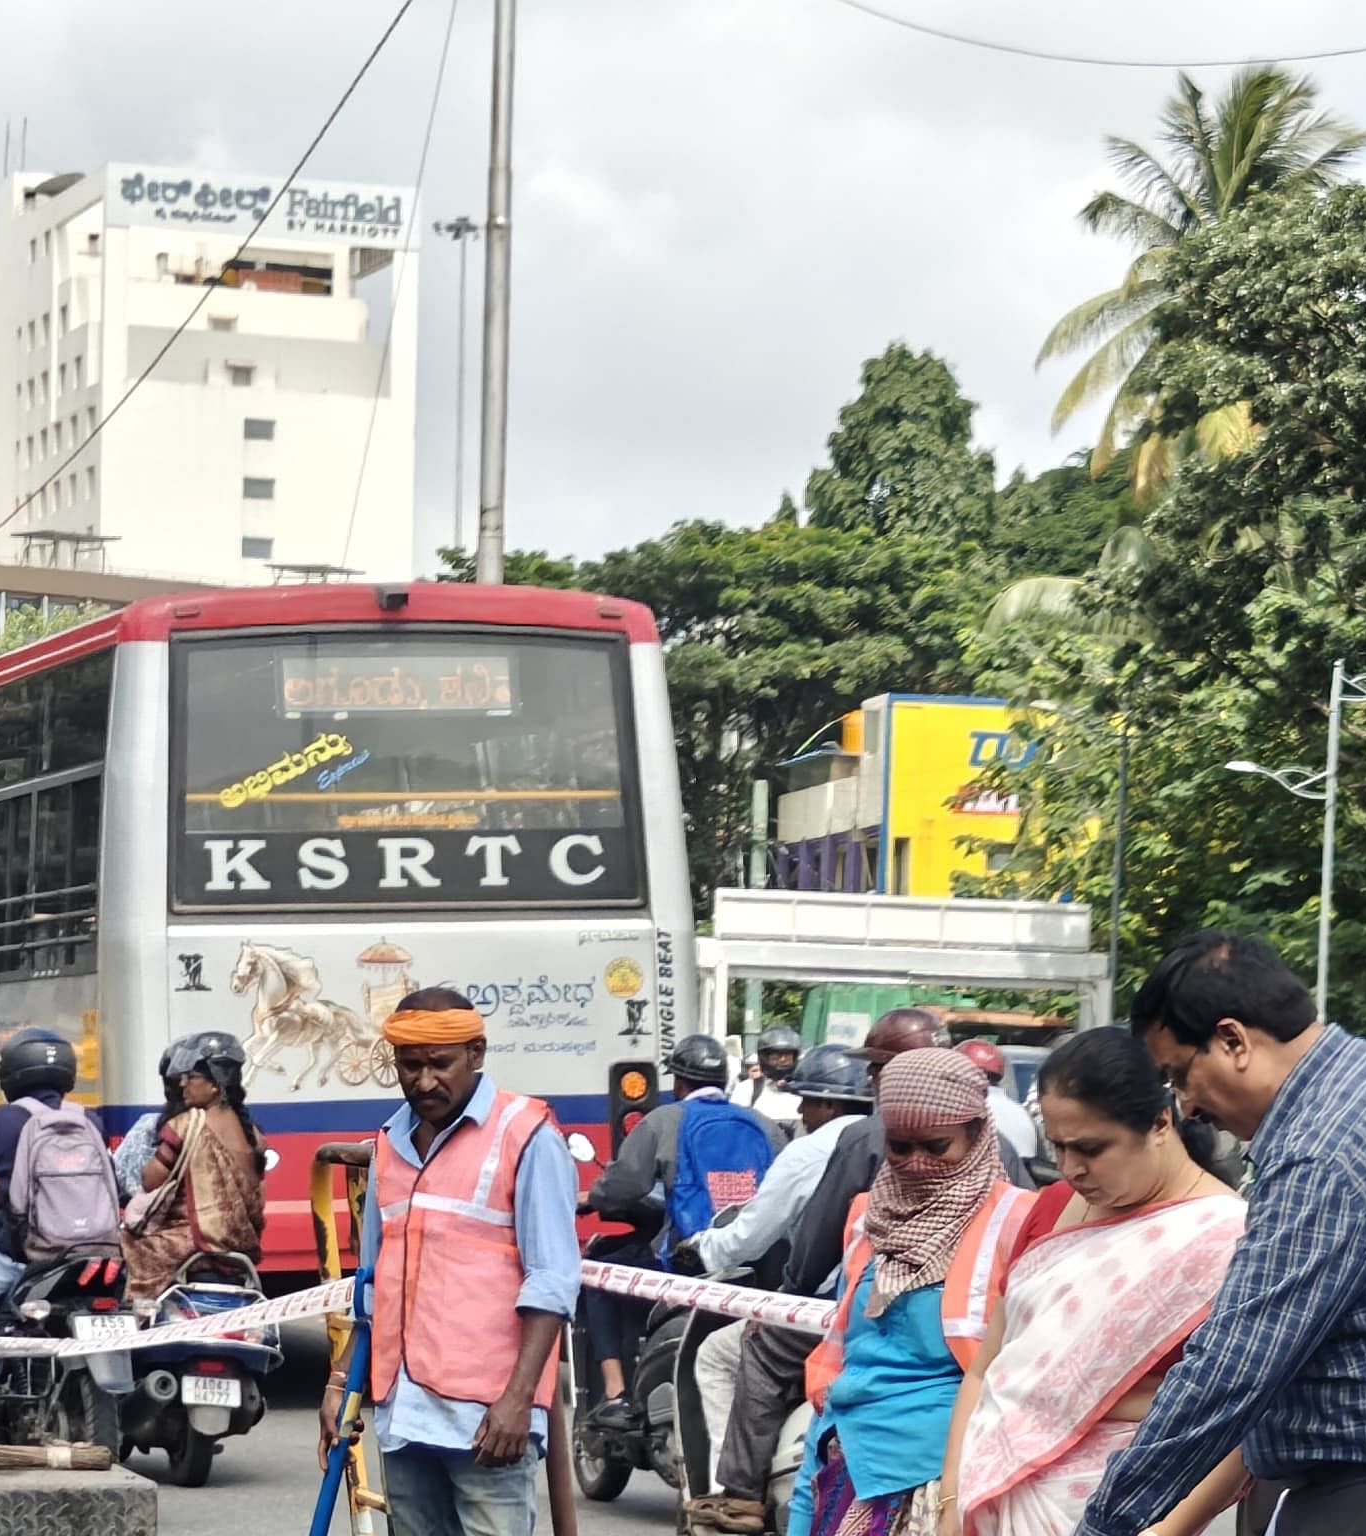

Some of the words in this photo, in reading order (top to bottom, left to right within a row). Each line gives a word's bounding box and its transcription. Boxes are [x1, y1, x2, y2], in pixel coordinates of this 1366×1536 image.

[285, 188, 403, 226] Fairfield
[286, 218, 306, 231] BY
[313, 221, 400, 238] MARRIOTT
[204, 833, 606, 891] KSRTC
[656, 927, 673, 979] BEAT
